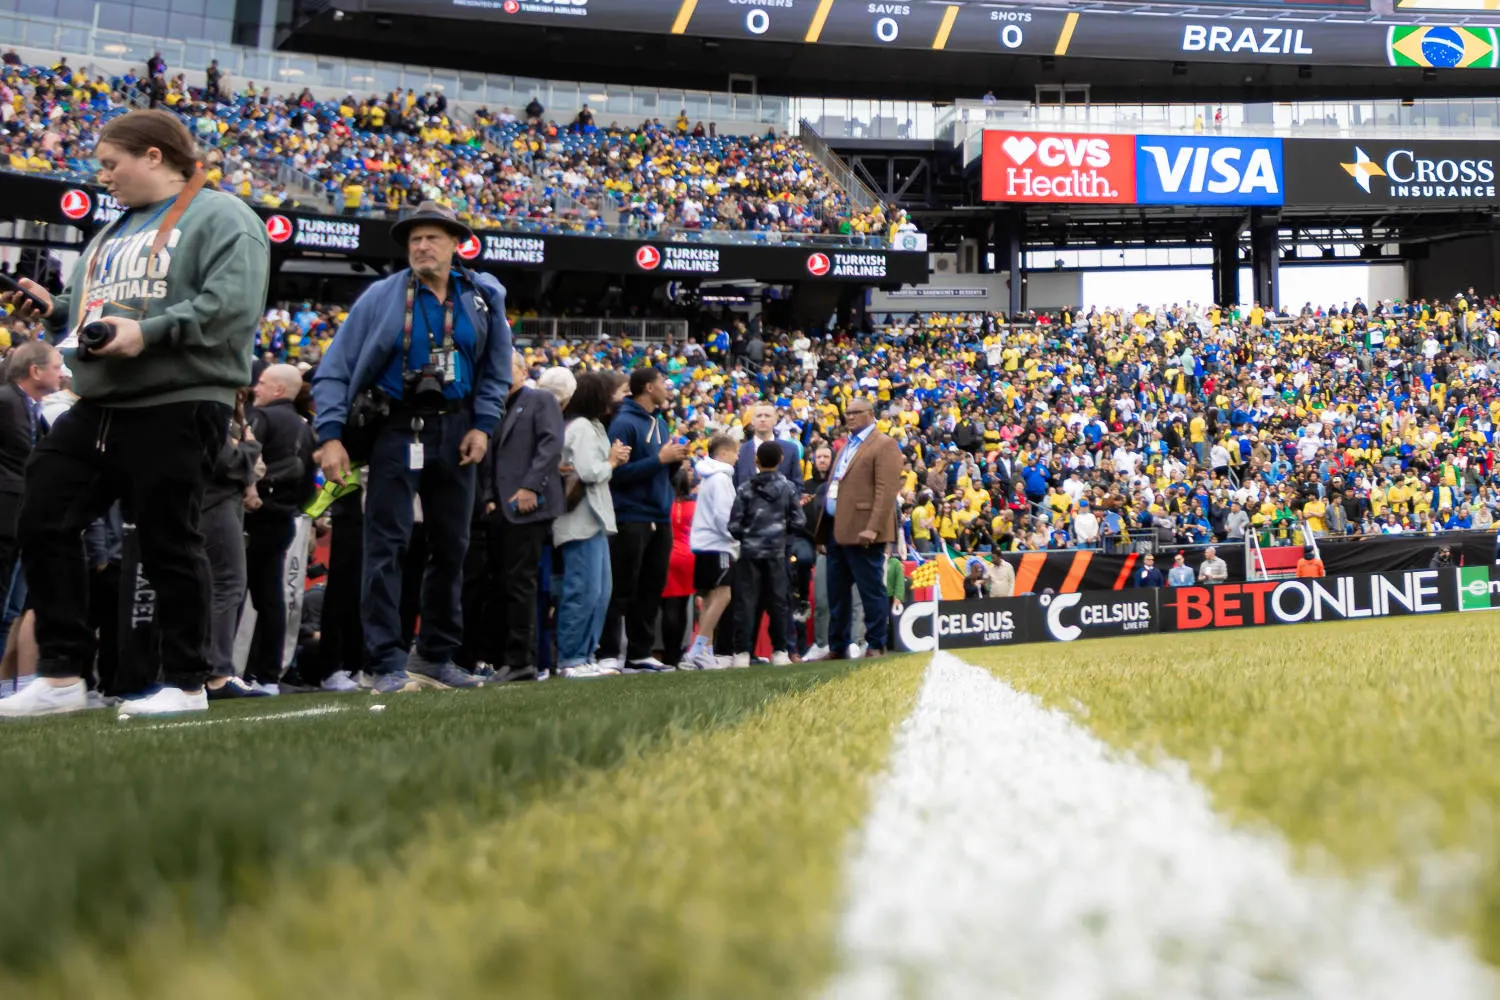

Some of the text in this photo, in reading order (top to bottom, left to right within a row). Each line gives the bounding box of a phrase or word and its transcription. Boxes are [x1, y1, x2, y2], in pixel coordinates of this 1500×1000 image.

[868, 3, 911, 16] SAVES
[991, 11, 1032, 23] SHOTS
[746, 9, 770, 34] 0
[876, 18, 899, 42] 0
[1001, 24, 1023, 48] 0
[1182, 24, 1313, 56] BRAZIL
[1036, 136, 1110, 168] CVS
[1141, 145, 1279, 194] VISA
[1390, 185, 1496, 198] INSURANCE
[297, 218, 360, 238] TURKISH
[295, 232, 360, 249] AIRLINES
[485, 236, 545, 252] TURKISH
[483, 247, 545, 264] AIRLINES
[664, 247, 720, 262] TURKISH
[834, 254, 887, 267] TURKISH
[663, 259, 720, 273] AIRLINES
[833, 264, 887, 278] AIRLINES
[1163, 570, 1442, 630] BETONLINE
[1122, 620, 1149, 631] LIVE FIT
[984, 630, 1013, 641] LIVE FIT
